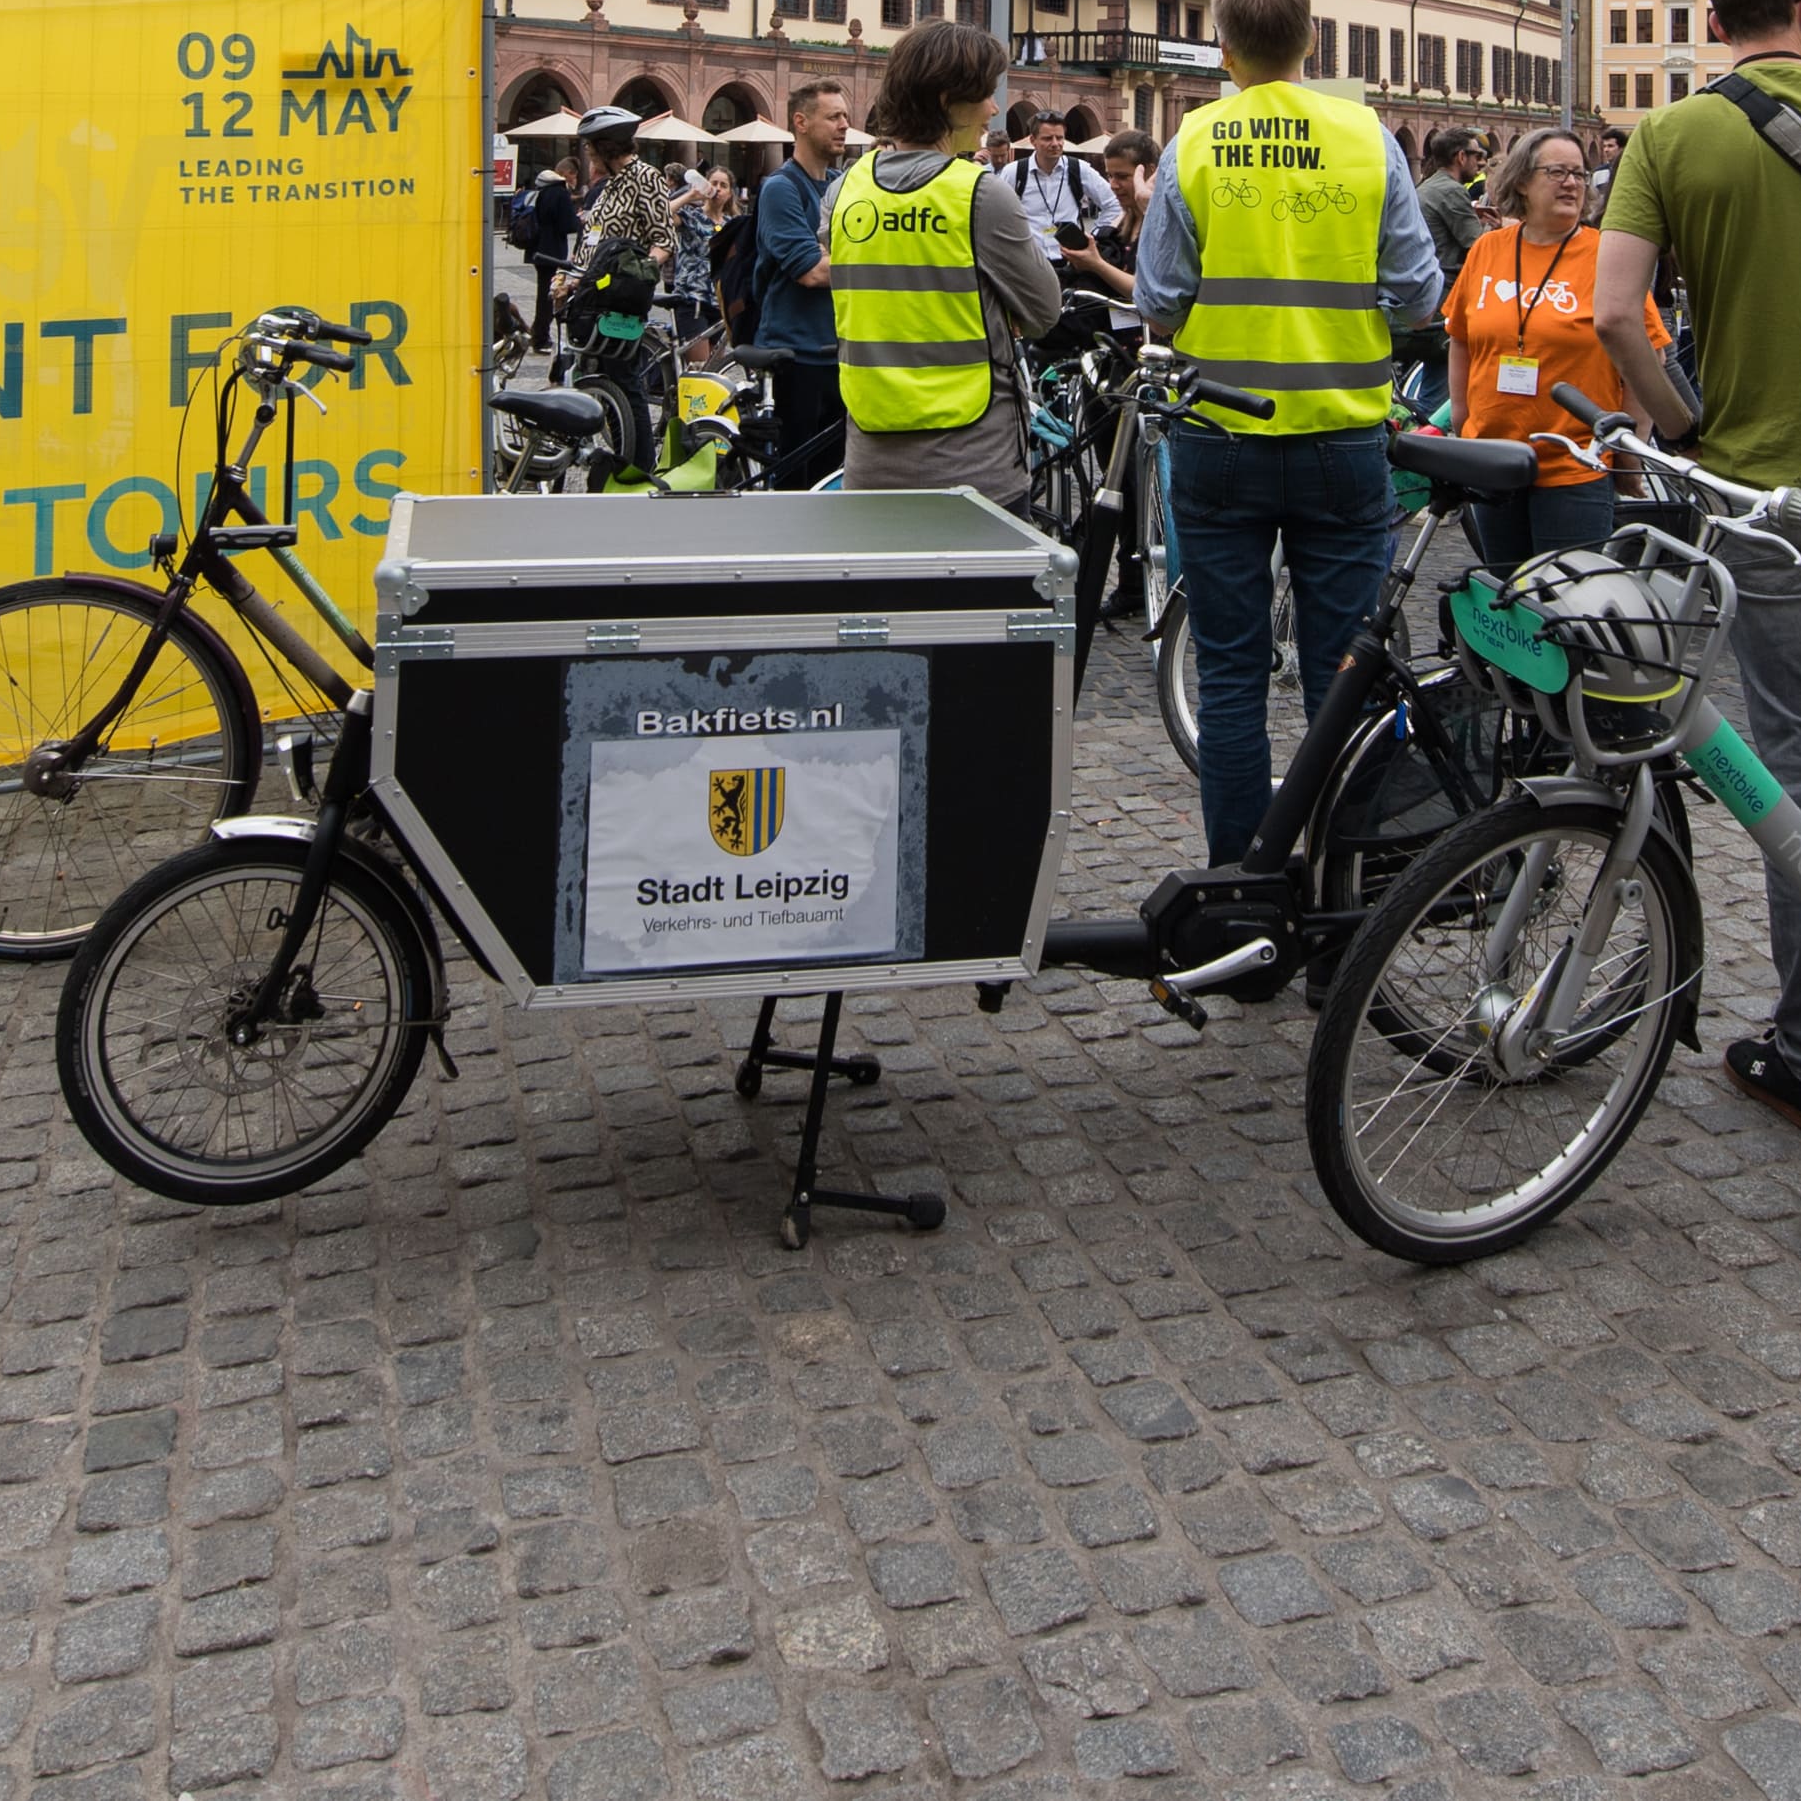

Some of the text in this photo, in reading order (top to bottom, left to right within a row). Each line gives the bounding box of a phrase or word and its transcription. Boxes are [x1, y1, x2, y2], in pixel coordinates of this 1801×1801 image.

[178, 32, 255, 80] 09
[183, 86, 413, 138] 12 MAY
[1212, 116, 1310, 141] GO WITH
[179, 158, 304, 179] LEADING
[1211, 144, 1326, 170] THE FLOW.
[180, 177, 415, 203] THE TRANSITION
[882, 206, 948, 235] adfc
[170, 300, 413, 407] FOR
[3, 449, 408, 576] TOURS
[1472, 606, 1543, 658] nextbike
[636, 702, 843, 735] Bakfiets.nl
[1708, 745, 1765, 815] nextbike
[636, 869, 850, 906] Stadt Leipzig
[642, 907, 845, 934] Verkehrs- und Tiefbauamt
